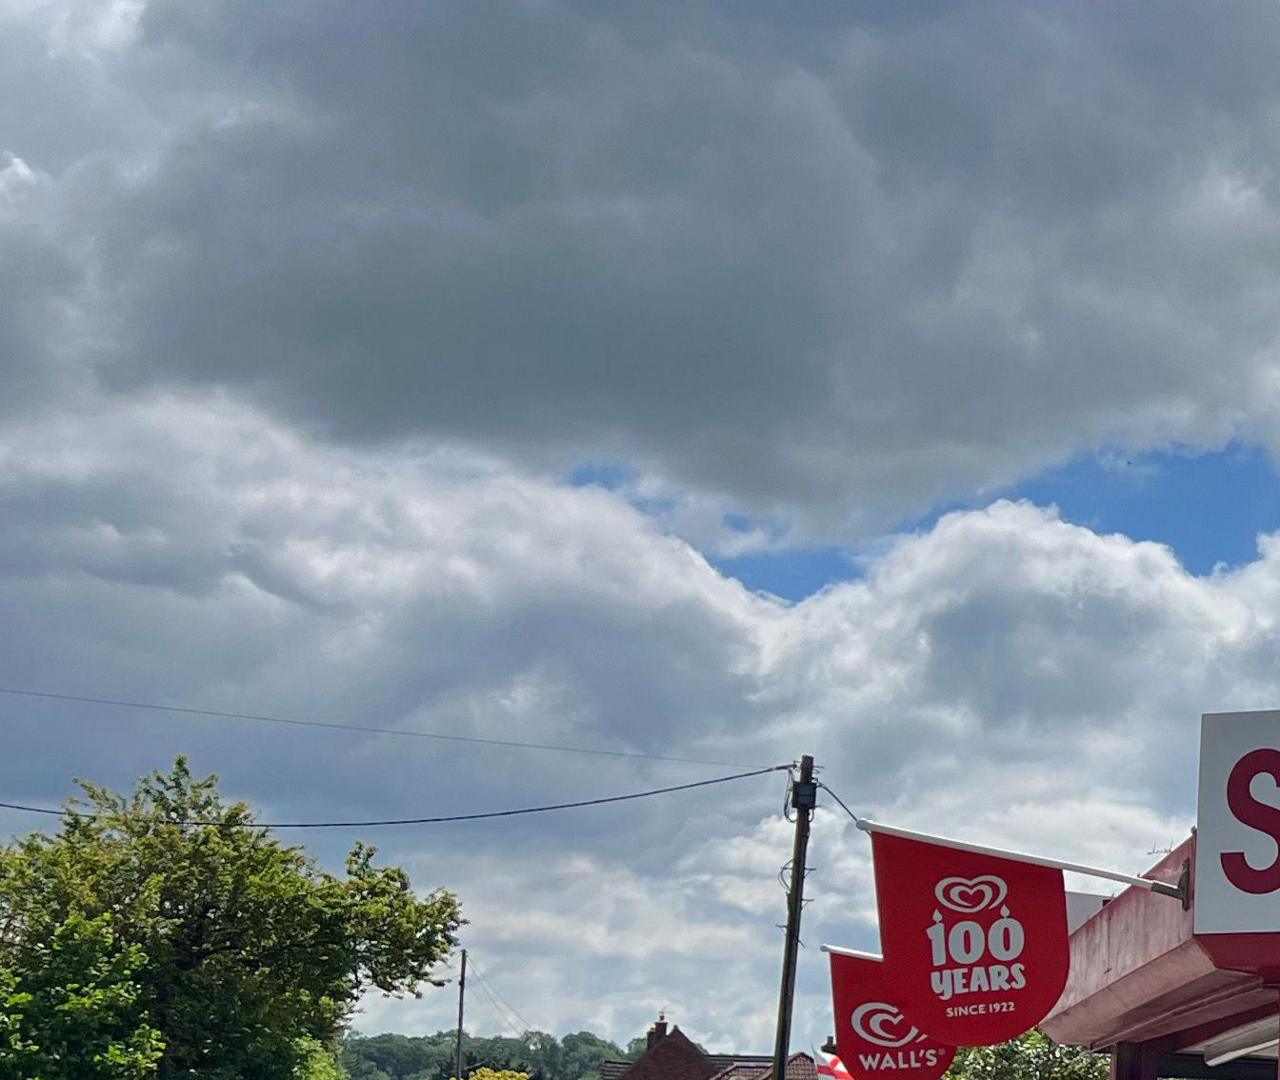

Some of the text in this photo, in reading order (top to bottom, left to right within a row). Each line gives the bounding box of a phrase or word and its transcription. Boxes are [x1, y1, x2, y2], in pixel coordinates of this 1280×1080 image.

[926, 916, 1025, 967] 100
[930, 963, 1027, 1000] YEARS
[946, 1001, 1016, 1017] SINCE 1922
[859, 1049, 938, 1071] WALL'S
